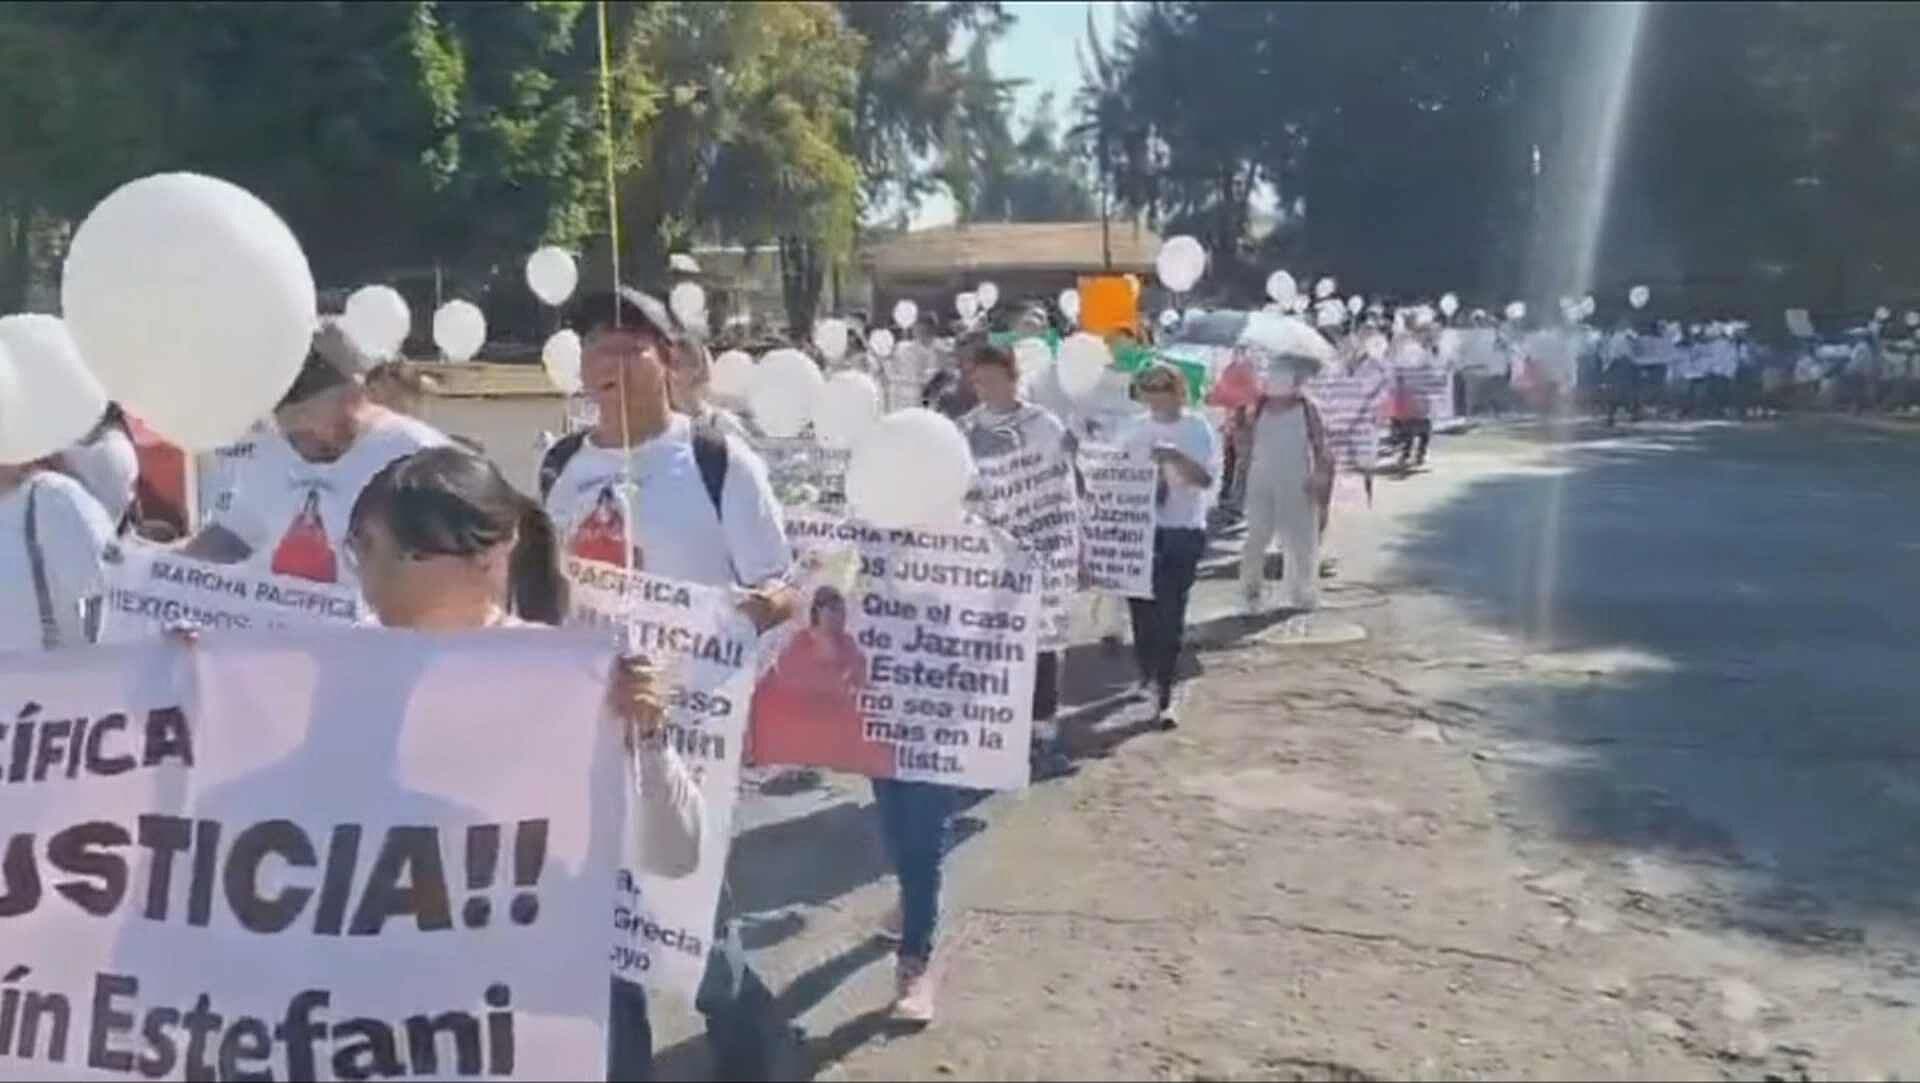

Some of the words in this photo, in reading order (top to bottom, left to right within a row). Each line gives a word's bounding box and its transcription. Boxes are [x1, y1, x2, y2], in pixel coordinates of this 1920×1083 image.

[889, 528, 990, 557] PACIFICA
[150, 562, 248, 598] MARCHA
[893, 559, 1033, 594] JUSTICIA!!
[862, 593, 919, 620] Que
[926, 603, 951, 626] el
[959, 610, 1026, 633] caso
[858, 626, 893, 651] de
[903, 625, 1026, 663] Jazmín
[869, 654, 1011, 696] Estefani
[860, 692, 894, 712] no
[902, 698, 955, 720] sea
[962, 702, 1015, 726] uno
[0, 701, 194, 784] ÍFICA
[933, 726, 970, 747] en
[978, 725, 1004, 751] la
[613, 905, 703, 959] Grecia
[88, 970, 516, 1082] Estefani
